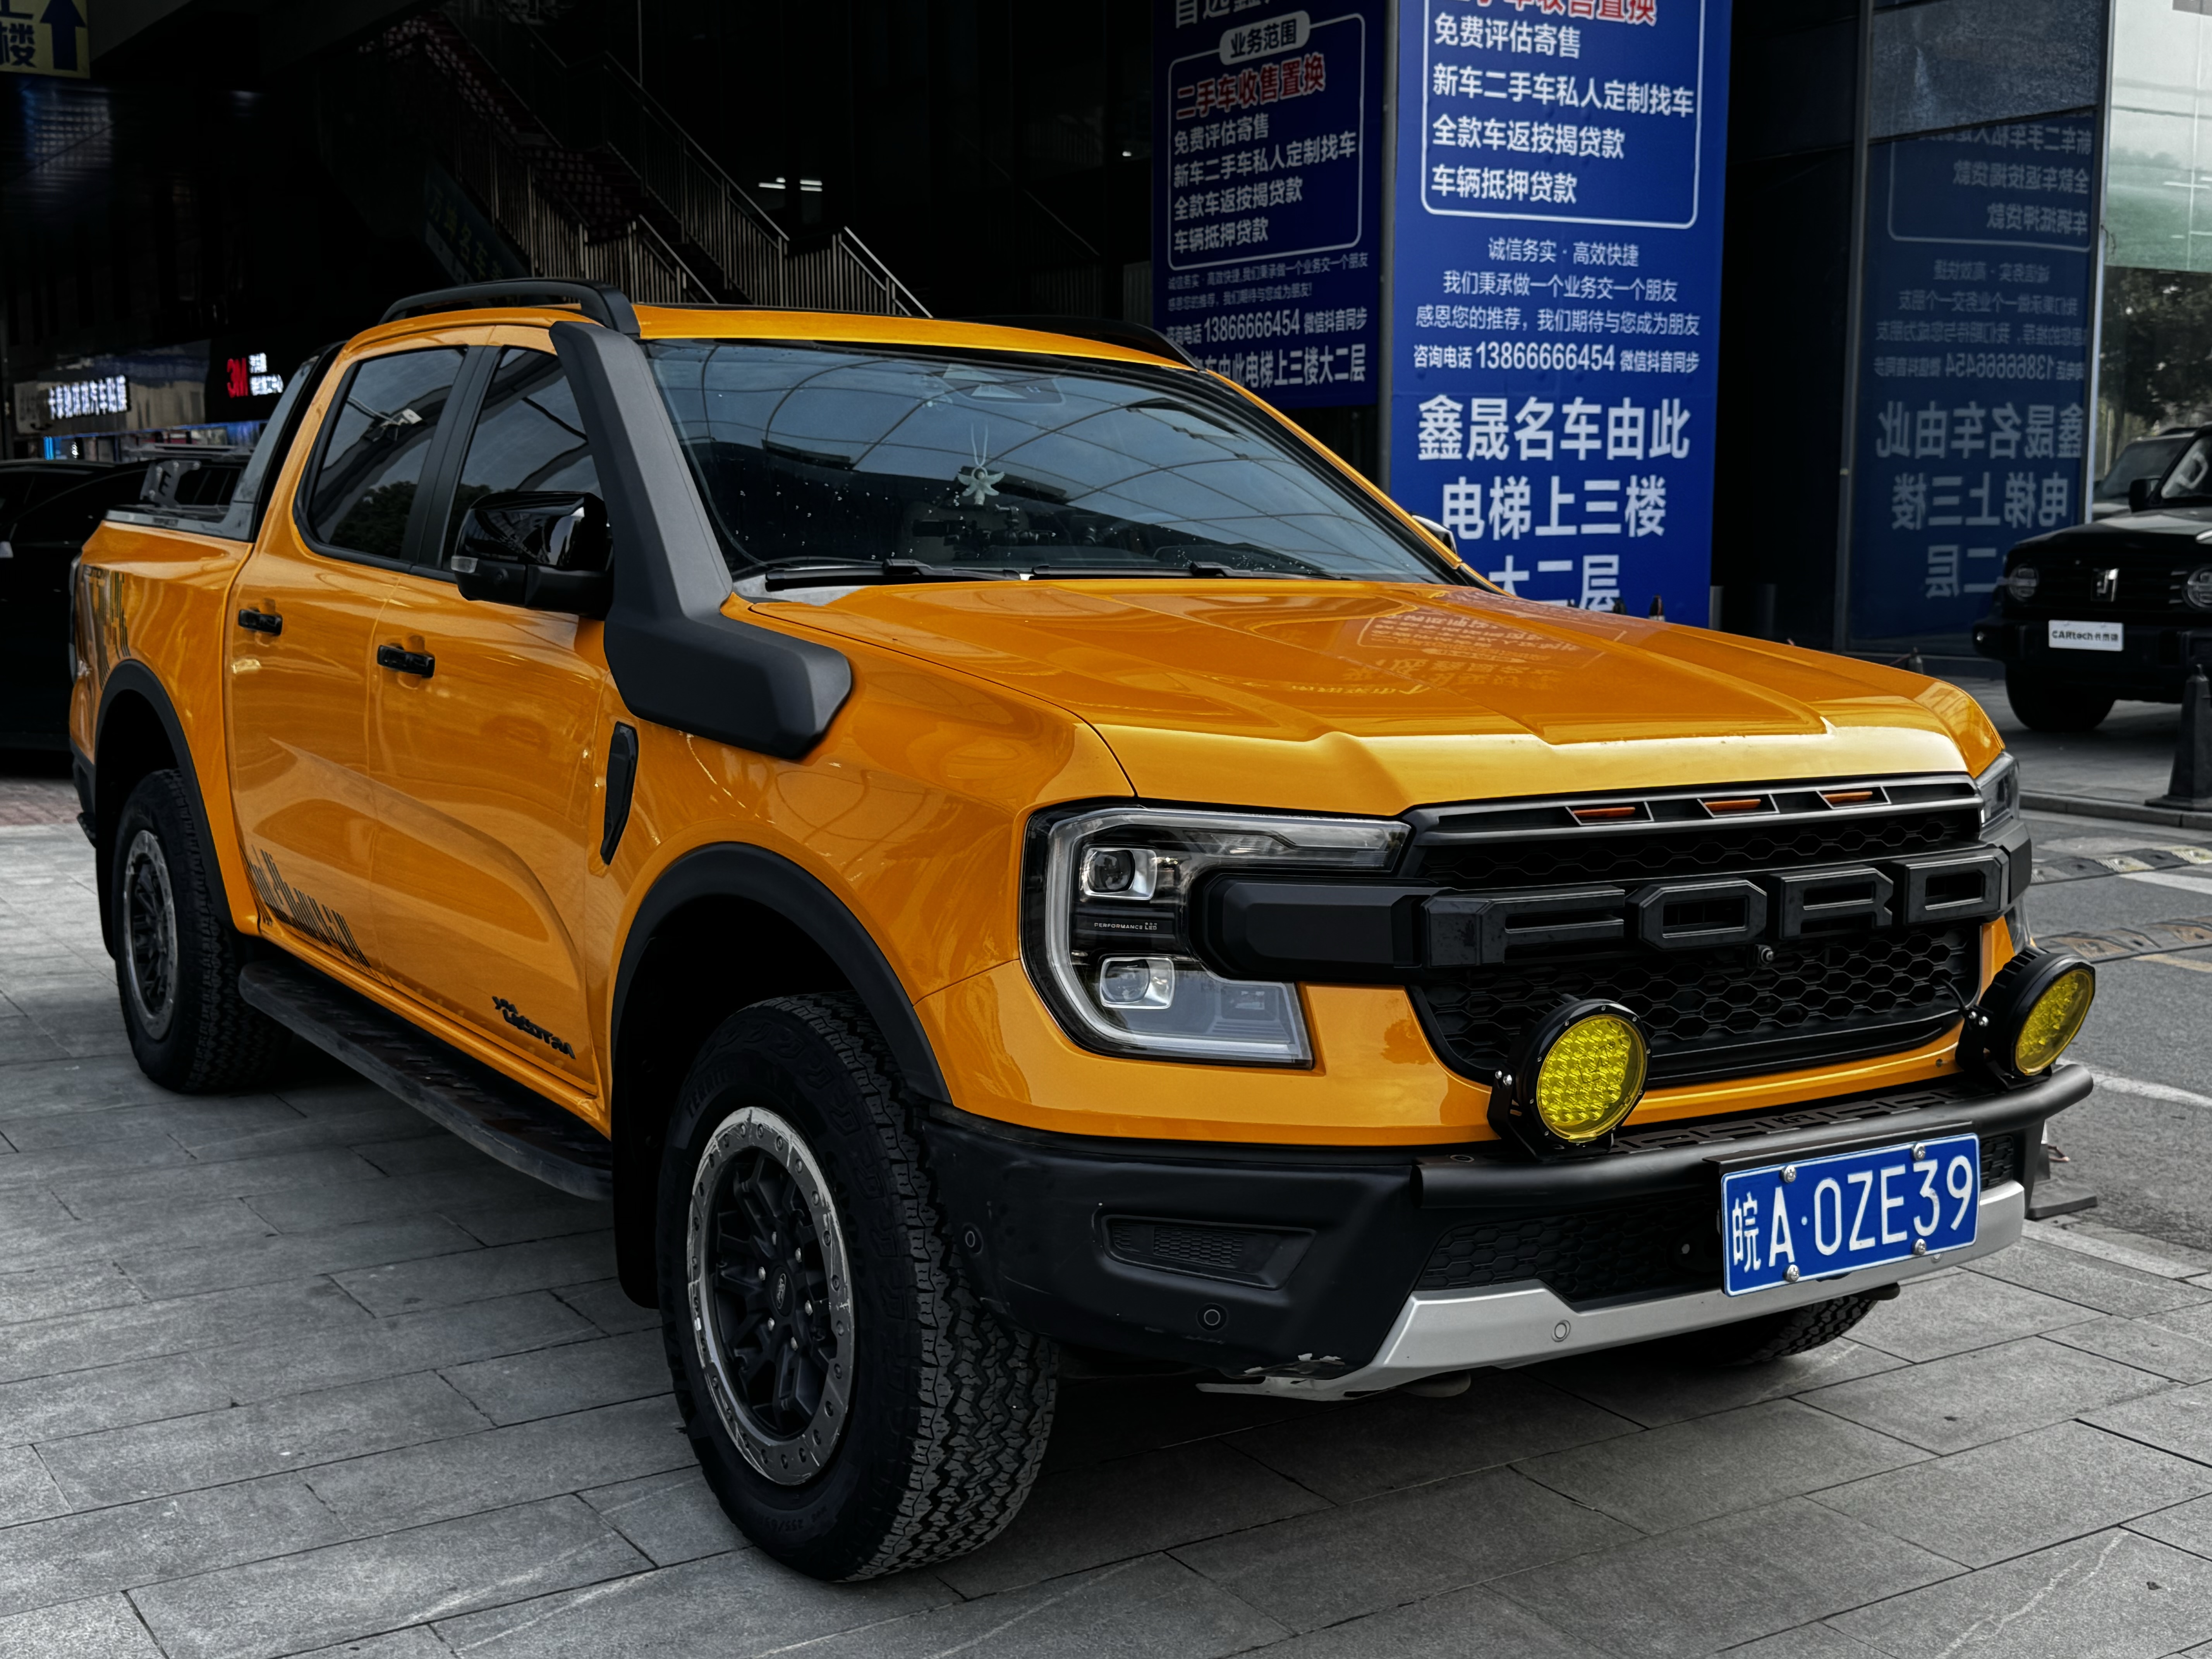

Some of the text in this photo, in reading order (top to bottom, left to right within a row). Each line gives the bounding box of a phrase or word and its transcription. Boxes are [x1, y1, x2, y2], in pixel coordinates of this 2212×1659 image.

[1230, 19, 1296, 58] 业务范围
[1434, 12, 1581, 59] 免费评估寄售
[1176, 52, 1326, 120] 二手车收售置换
[1433, 63, 1695, 117] 新车二手车私人定制找车
[1175, 113, 1268, 155] 免费评估寄售
[1432, 114, 1625, 159] 全款车返按揭贷款
[1174, 131, 1356, 187] 新车二手车私人定制找车
[1175, 177, 1303, 221] 全款车返按揭贷款
[1431, 165, 1577, 204] 车辆抵押贷款
[1175, 217, 1268, 254] 车辆抵押贷款
[1443, 271, 1678, 302] 我们秉承做一个业务交一个朋友
[1204, 309, 1300, 342] 13866666454
[227, 357, 248, 399] 3M
[1413, 342, 1700, 373] 咨询电话 13866666454 微信抖音同步
[1418, 395, 1690, 460] 鑫晟名车由此
[1443, 475, 1666, 540] 电梯上三楼
[1489, 555, 1620, 612] 大二层
[1427, 847, 2012, 966] FORD
